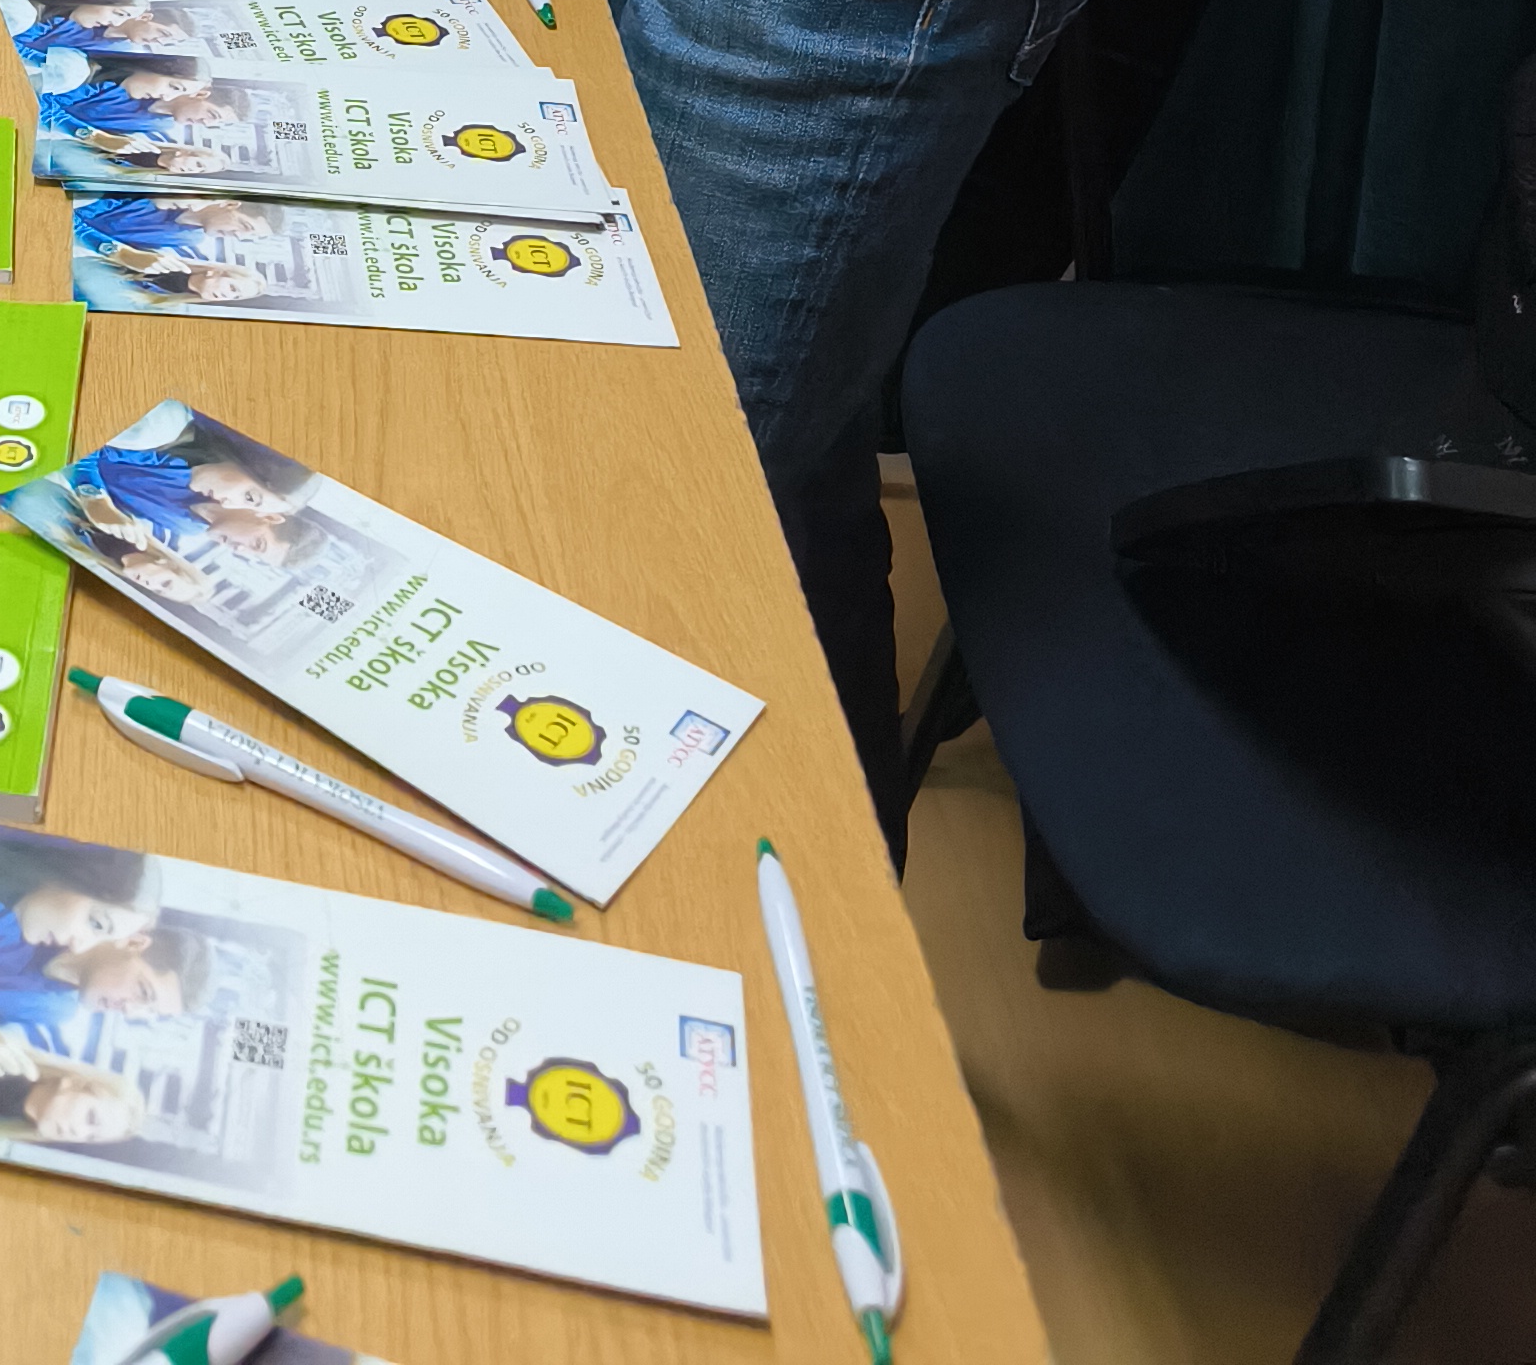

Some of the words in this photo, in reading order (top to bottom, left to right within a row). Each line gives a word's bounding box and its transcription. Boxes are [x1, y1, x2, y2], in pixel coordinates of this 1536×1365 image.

[274, 6, 306, 28] ICT
[317, 10, 357, 60] Visoka
[353, 5, 367, 18] OD
[402, 21, 426, 40] ICT
[433, 8, 449, 19] 50
[446, 17, 470, 50] GODINA
[289, 32, 328, 65] škol
[352, 17, 396, 60] OSNIVANJA
[317, 89, 341, 175] www.ict.edu.rs
[344, 98, 372, 127] ICT
[428, 109, 446, 123] OD
[348, 127, 379, 170] škola
[387, 112, 418, 165] Visoka
[421, 122, 456, 169] OSNIVANJA
[477, 133, 499, 154] ICT
[517, 121, 536, 134] 50
[528, 135, 549, 170] GODINA
[390, 243, 424, 291] škola
[431, 222, 466, 283] Visoka
[467, 234, 507, 288] OSNIVANJA
[527, 244, 551, 268] ICT
[570, 232, 589, 246] 50
[584, 247, 604, 287] GODINA
[305, 572, 429, 680] www.ict.edu.rs
[414, 597, 462, 647] ICT
[346, 635, 427, 693] škola
[407, 638, 500, 711] Visoka
[515, 661, 547, 676] OD
[461, 669, 514, 744] OSNIVANJA
[537, 712, 578, 749] ICT
[623, 724, 641, 747] 50
[571, 748, 638, 798] GODINA
[357, 976, 398, 1044] ICT
[490, 1016, 523, 1047] OD
[300, 948, 341, 1165] www.ict.edu.rs
[633, 1060, 664, 1090] 50
[346, 1048, 395, 1157] škola
[417, 1015, 464, 1148] Visoka
[564, 1079, 592, 1132] ICT
[471, 1046, 517, 1169] OSNIVANJA
[638, 1093, 677, 1183] GODINA
